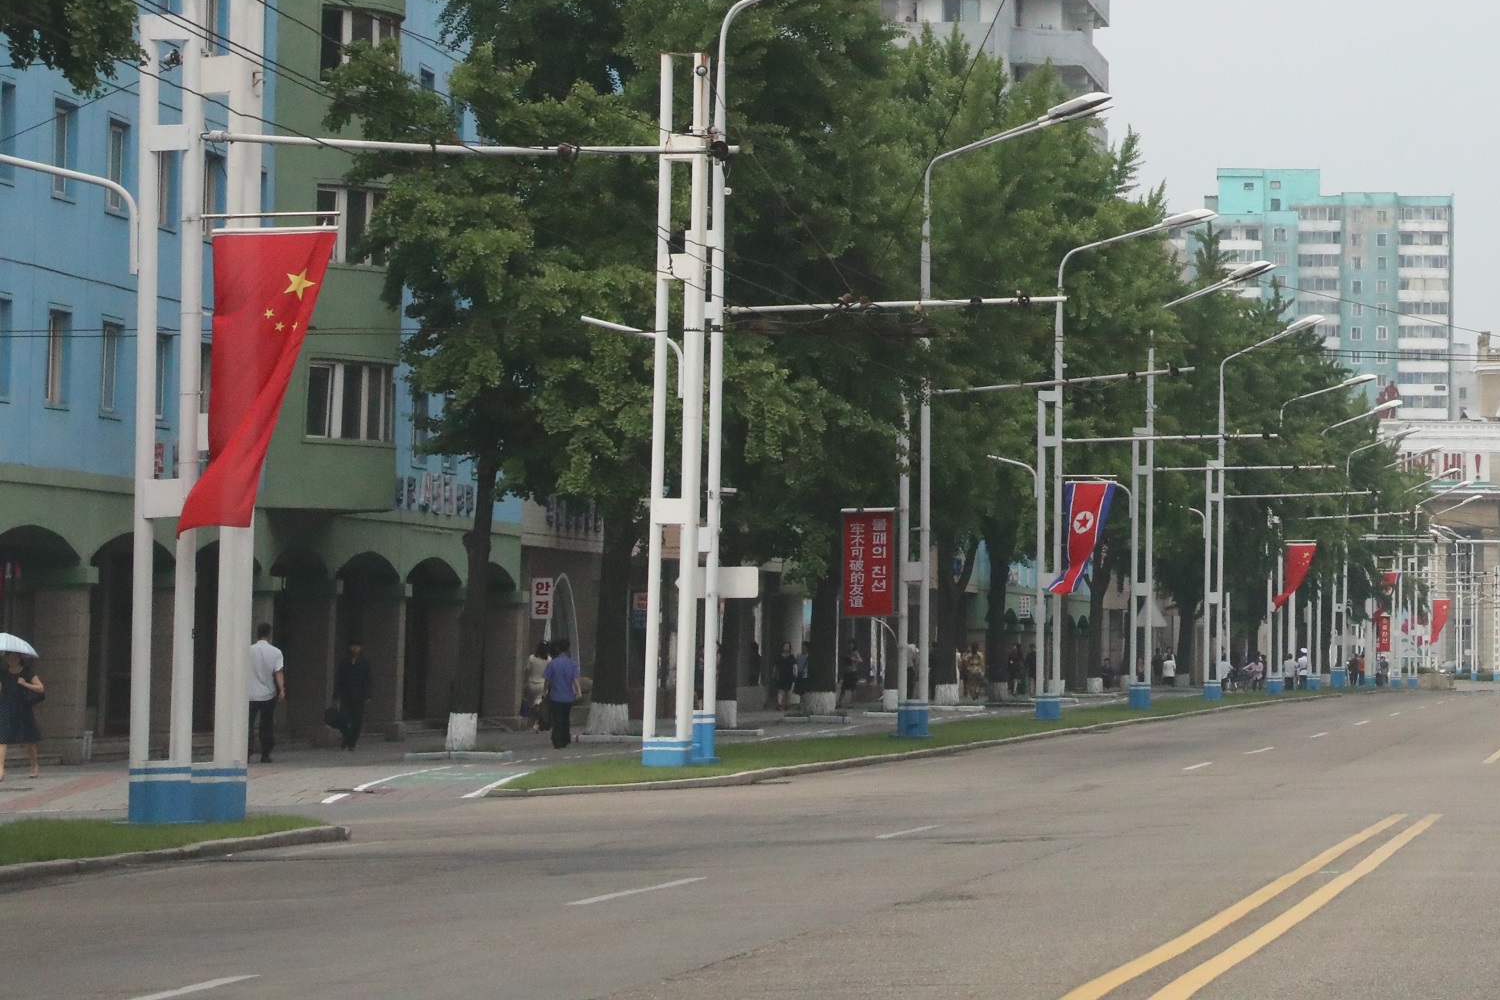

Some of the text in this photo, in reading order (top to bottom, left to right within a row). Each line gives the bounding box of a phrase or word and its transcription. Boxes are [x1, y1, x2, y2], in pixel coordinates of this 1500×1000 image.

[849, 523, 865, 608] 牢不可破的友谊
[872, 565, 886, 592] 친선
[535, 582, 550, 615] 안경
